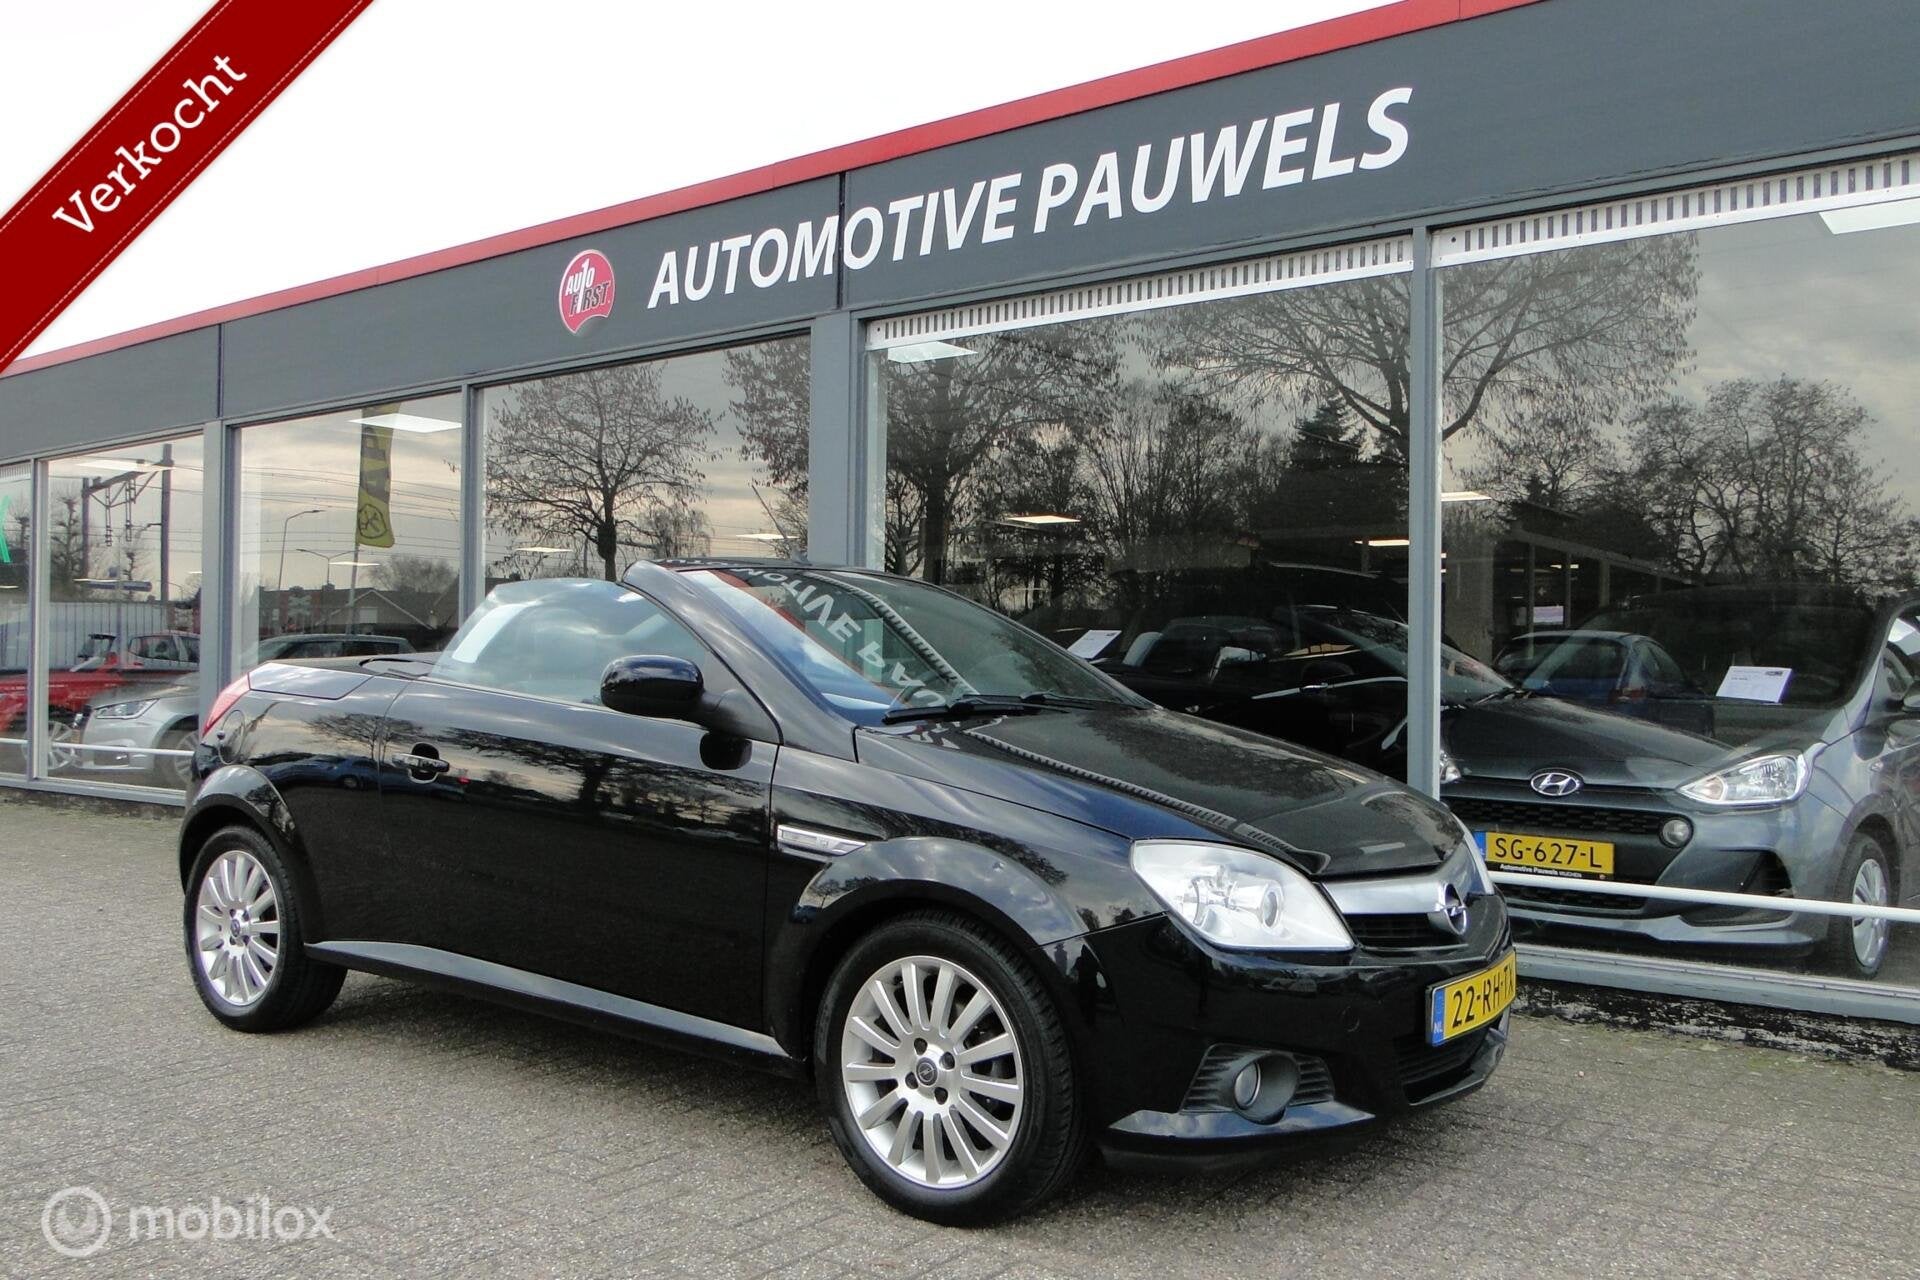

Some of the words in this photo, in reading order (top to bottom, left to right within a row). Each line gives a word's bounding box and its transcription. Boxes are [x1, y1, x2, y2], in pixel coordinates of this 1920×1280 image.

[647, 172, 1022, 310] AUTOMOTIVE
[1034, 87, 1413, 234] PAUWELS
[1495, 837, 1602, 868] SG-627-L
[1452, 962, 1514, 1029] 22-RH-TX
